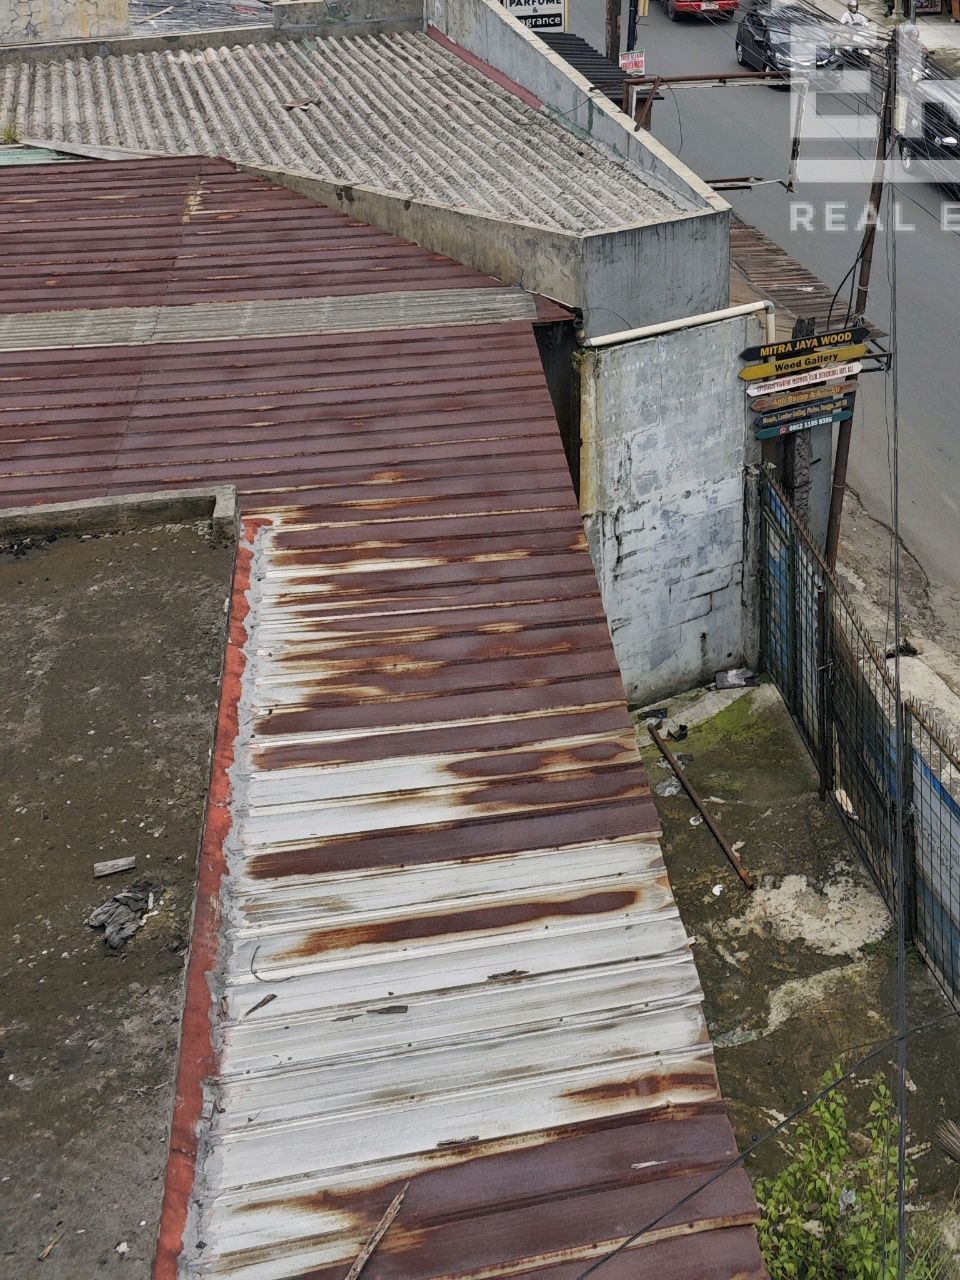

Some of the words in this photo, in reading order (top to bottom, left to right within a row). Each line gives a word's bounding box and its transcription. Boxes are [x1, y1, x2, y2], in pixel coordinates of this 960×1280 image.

[521, 15, 561, 28] agrance
[760, 343, 792, 357] MITRA
[794, 339, 818, 351] JAYA
[820, 331, 852, 345] WOOD
[774, 360, 802, 372] Wood
[804, 353, 838, 366] Gallery
